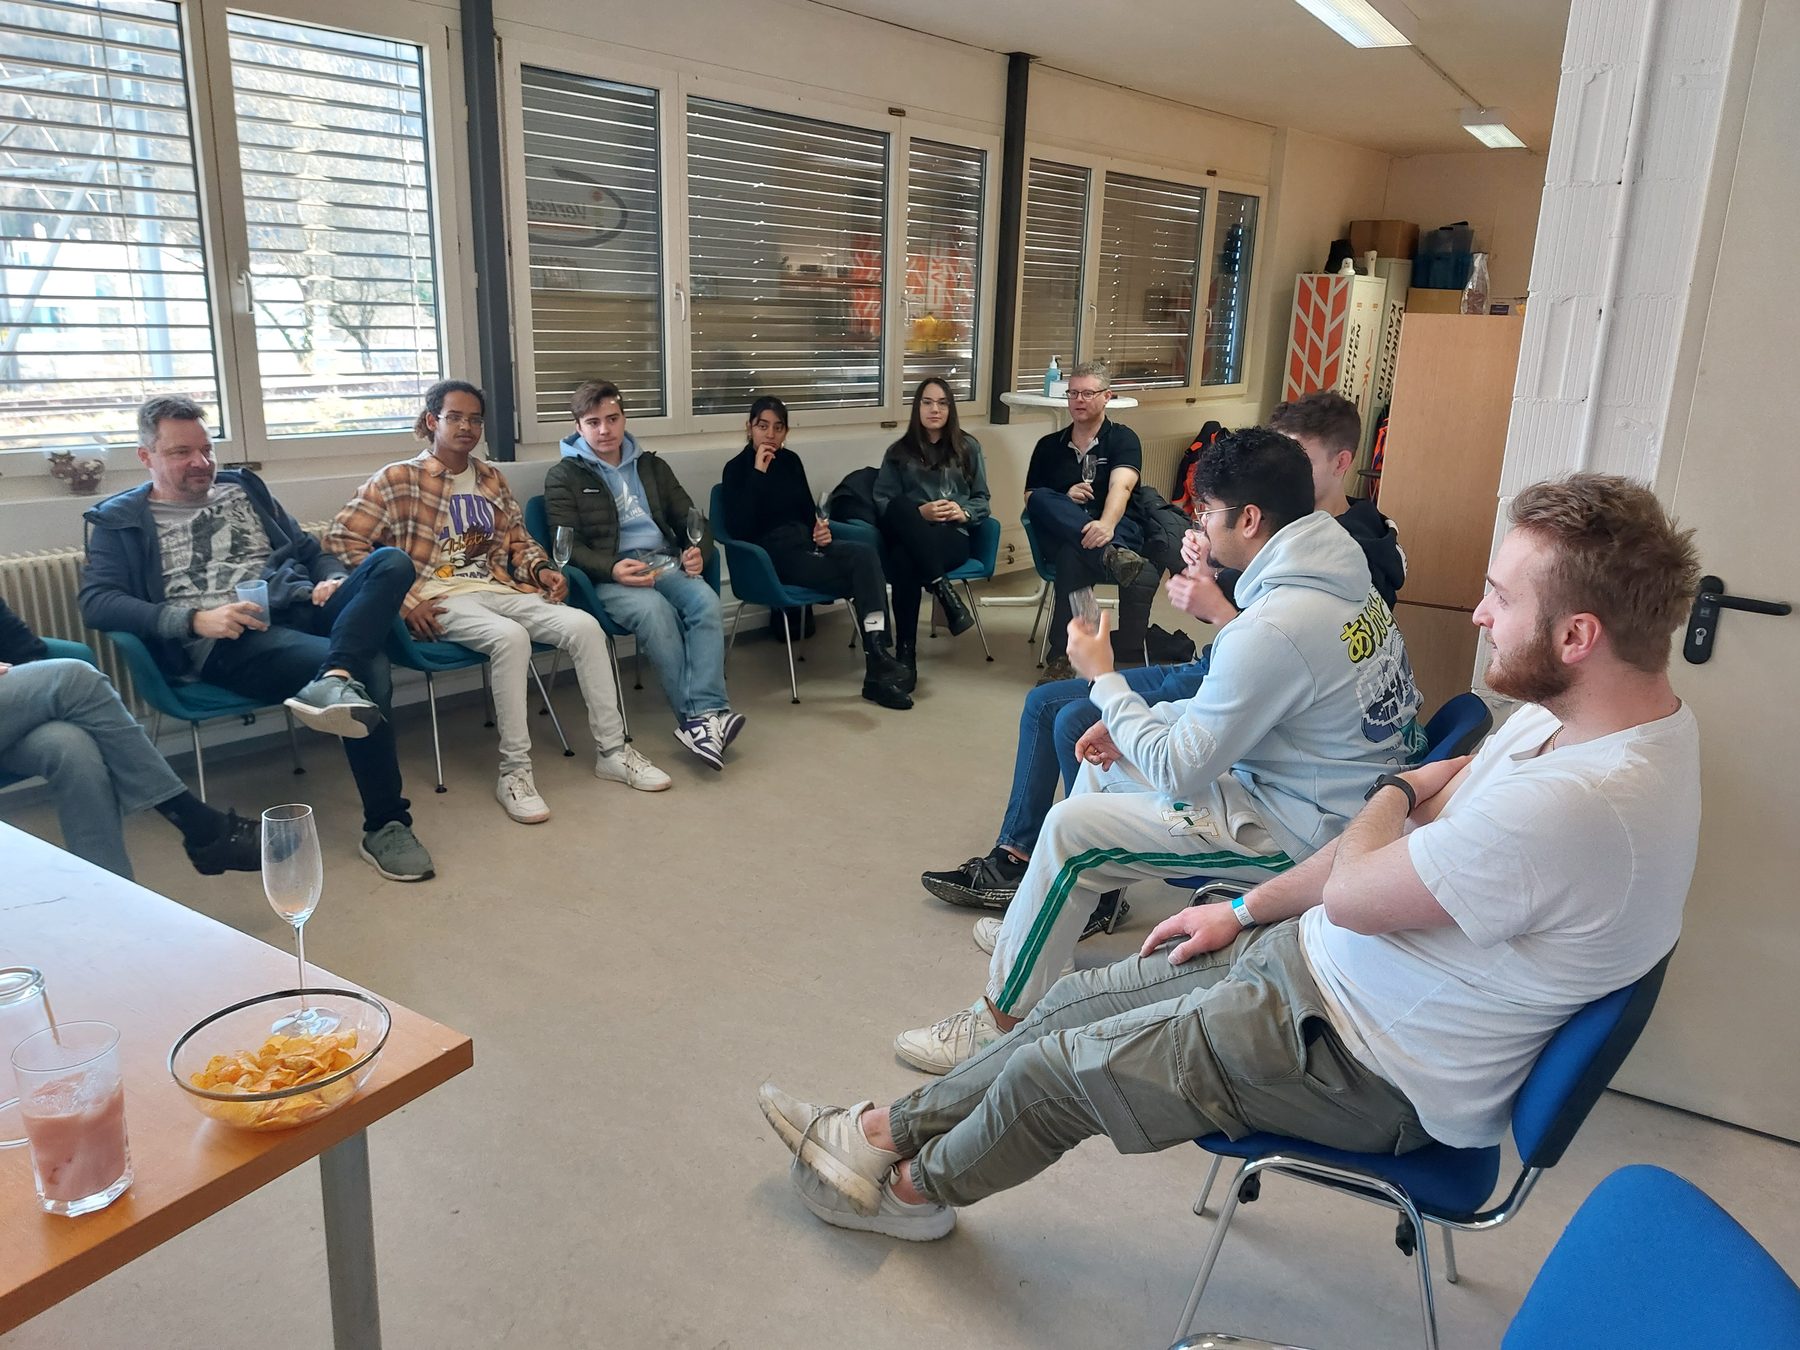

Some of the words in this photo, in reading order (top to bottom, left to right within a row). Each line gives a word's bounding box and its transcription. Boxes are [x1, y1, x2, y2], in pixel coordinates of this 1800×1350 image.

[1348, 323, 1361, 398] DETTEN
[1377, 302, 1397, 400] KADETTEN
[1384, 305, 1404, 400] VERKEHRS
